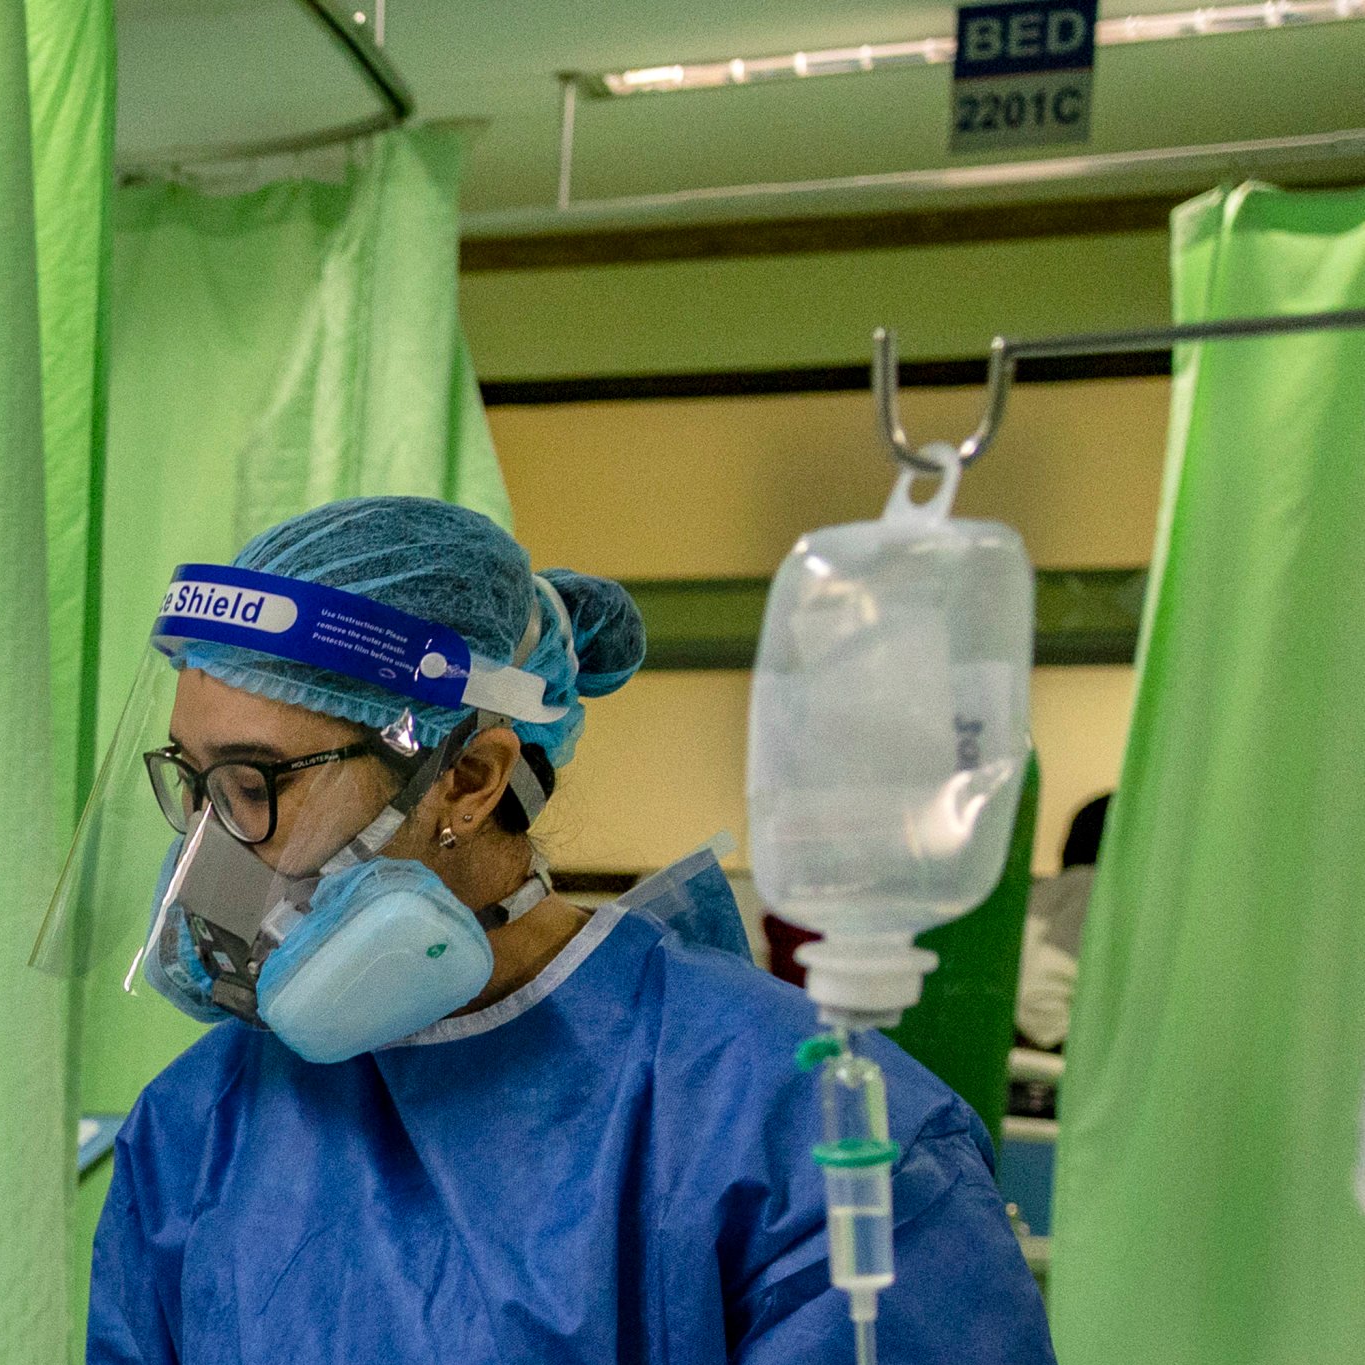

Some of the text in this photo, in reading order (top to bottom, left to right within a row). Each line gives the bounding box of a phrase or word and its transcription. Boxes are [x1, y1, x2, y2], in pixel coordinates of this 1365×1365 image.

[965, 10, 1087, 61] BED
[957, 87, 1083, 133] 2201C
[174, 585, 265, 623] Shield
[317, 621, 406, 655] remove the outer plastic
[321, 608, 336, 619] Use
[385, 629, 408, 643] Please
[312, 632, 414, 673] Protective film before using
